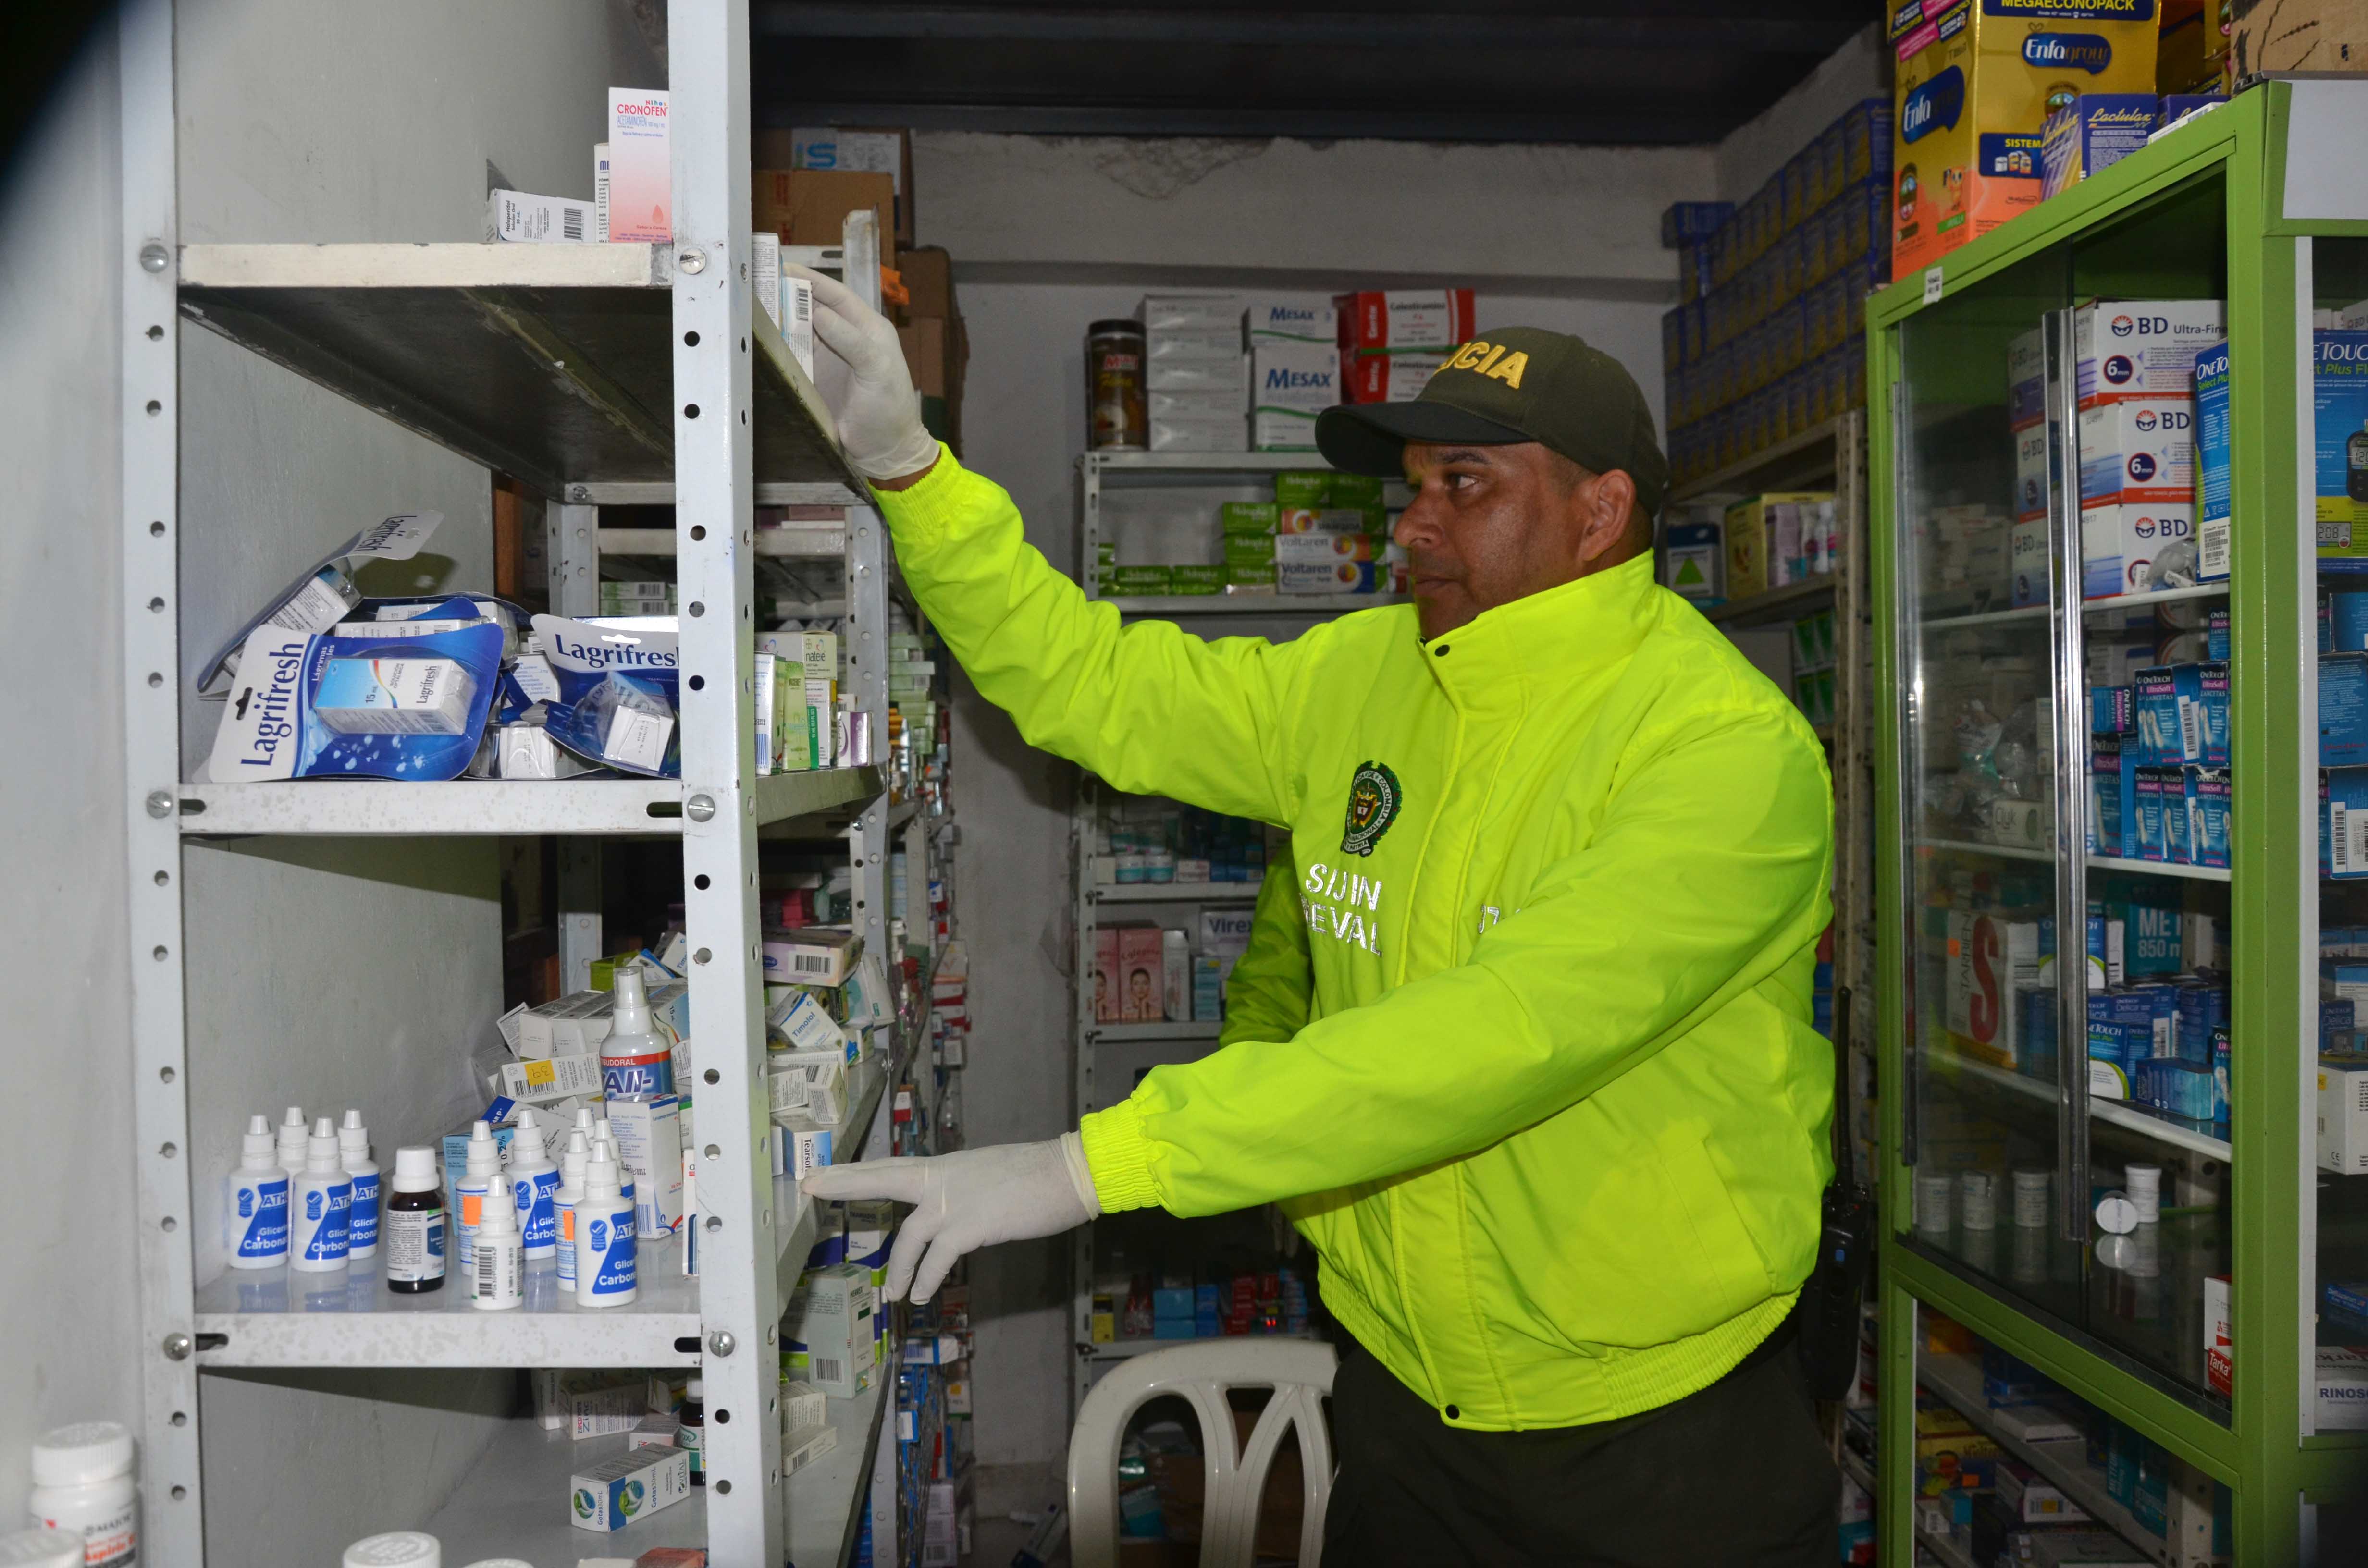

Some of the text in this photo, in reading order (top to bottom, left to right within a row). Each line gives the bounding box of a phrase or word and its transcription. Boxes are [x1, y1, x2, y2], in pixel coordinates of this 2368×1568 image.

[2001, 0, 2134, 11] MEGAECONOPACK
[617, 104, 666, 116] CRONOFEN
[2005, 138, 2041, 147] SISTEM
[2137, 317, 2168, 334] BD
[2197, 356, 2228, 380] ONETO
[2161, 412, 2191, 429] BD
[2159, 520, 2188, 536] BD
[1281, 563, 1332, 574] Voltaren
[311, 647, 327, 681] Lágrimas
[416, 666, 437, 704] Lagrifresh
[241, 643, 304, 766] Lagrifresh
[365, 693, 376, 703] 15
[1378, 778, 1391, 820] COLOMBIA
[1305, 863, 1382, 911] SIJIN
[2137, 939, 2166, 957] 850
[792, 1011, 816, 1038] Timolol
[2089, 1023, 2122, 1036] ETOUCH
[602, 1058, 636, 1066] SUDORAL
[499, 1135, 508, 1160] 0.2%
[358, 1187, 379, 1200] ATH
[541, 1183, 559, 1199] ATH
[262, 1191, 288, 1207] ATH
[332, 1196, 351, 1210] ATH
[259, 1225, 288, 1236] Gliceri
[526, 1229, 555, 1240] Carbo
[617, 1224, 635, 1238] ATH
[243, 1237, 287, 1250] Carbona
[312, 1239, 349, 1252] Carbon
[615, 1259, 635, 1270] Glice
[598, 1271, 635, 1286] Carbon
[2210, 1352, 2230, 1376] Tarka
[98, 1514, 131, 1531] MAJOR
